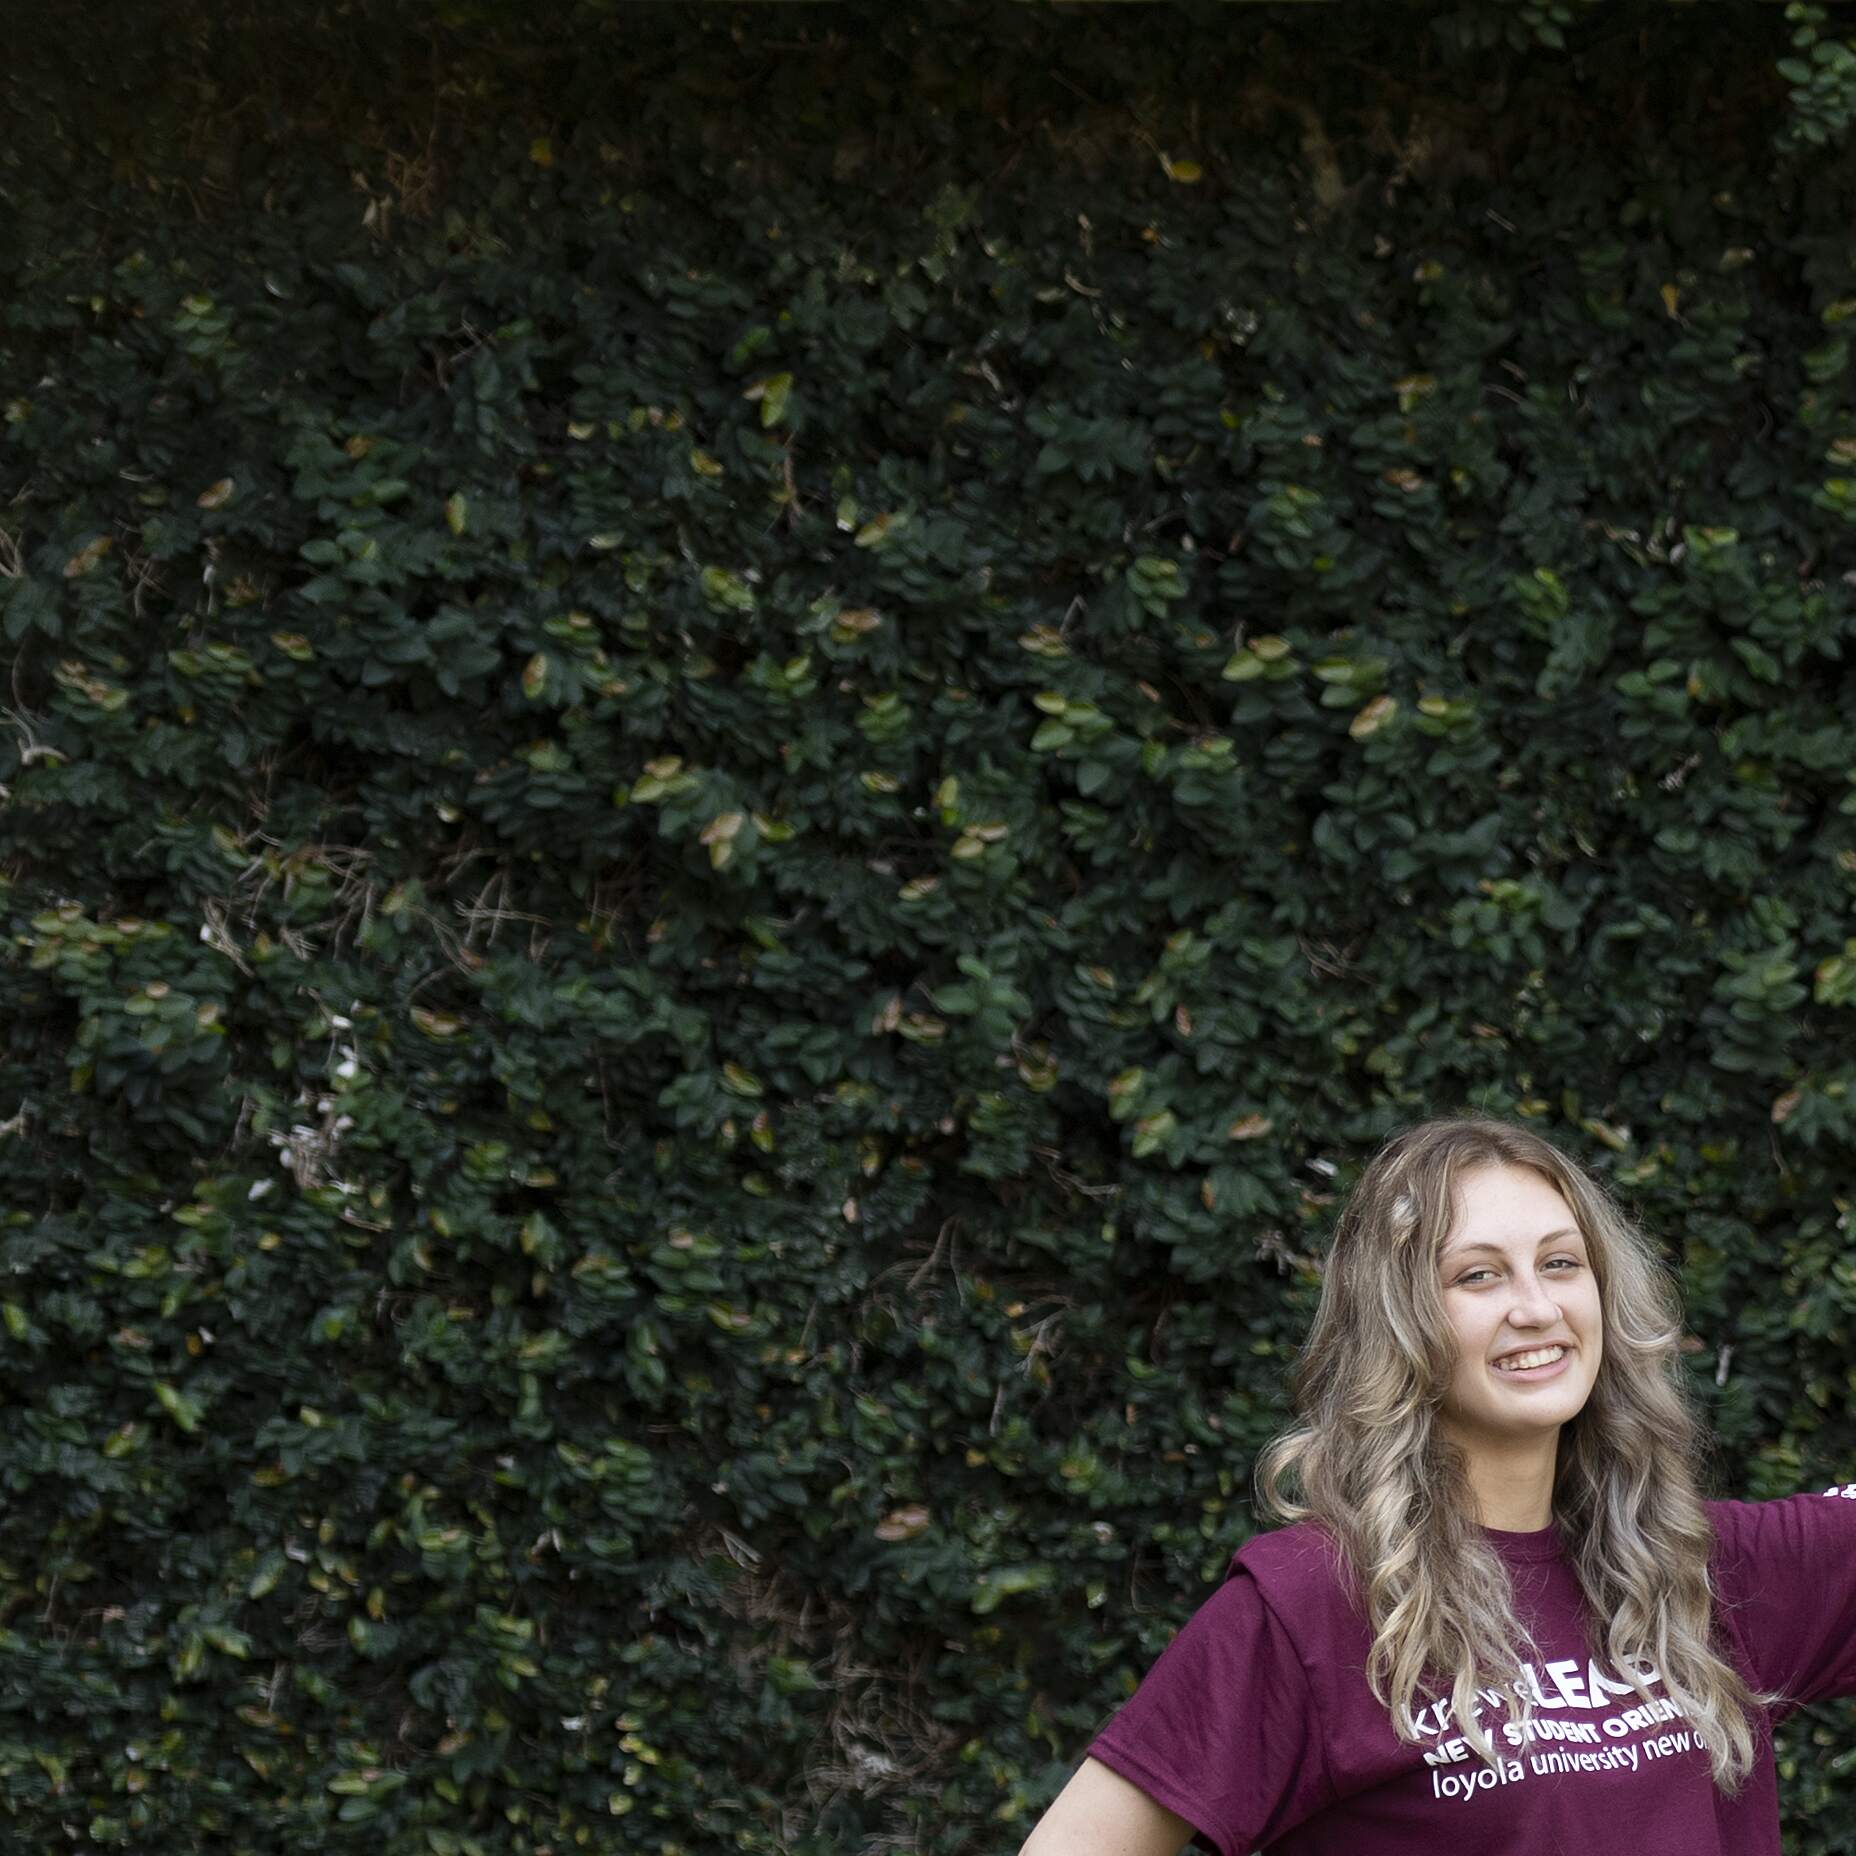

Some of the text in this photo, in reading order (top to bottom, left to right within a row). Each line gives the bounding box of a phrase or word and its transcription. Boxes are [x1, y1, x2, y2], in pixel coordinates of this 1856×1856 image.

[1503, 1719, 1601, 1746] STUDENT
[1432, 1755, 1525, 1802] loyola
[1530, 1743, 1638, 1776] university
[1642, 1730, 1691, 1761] new
